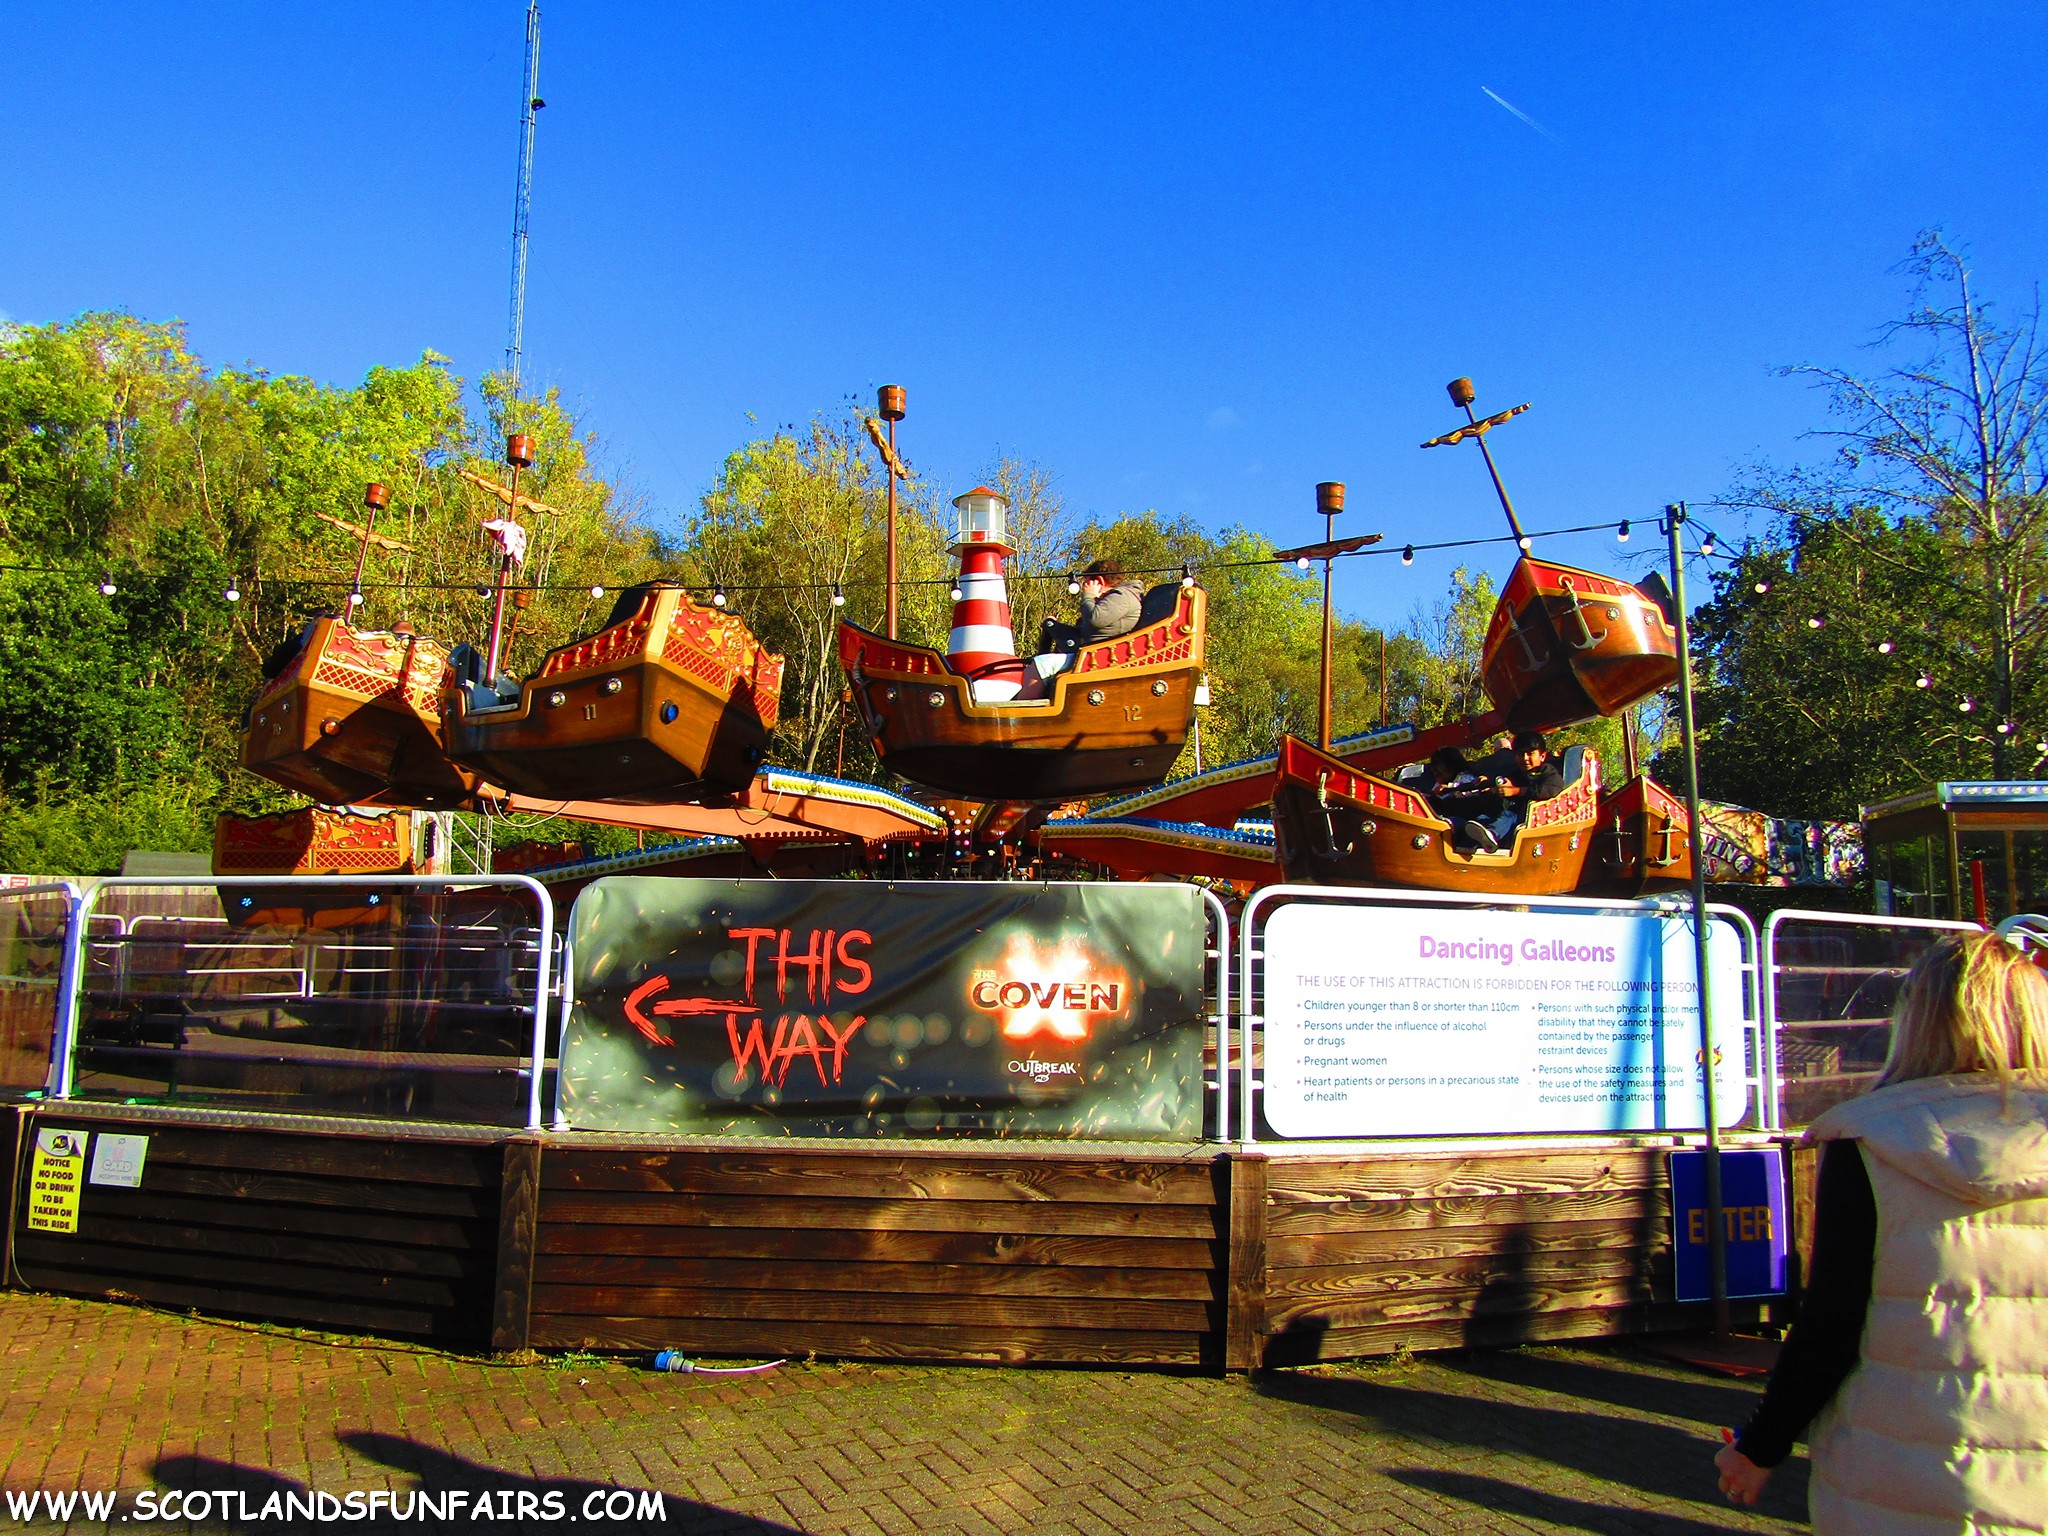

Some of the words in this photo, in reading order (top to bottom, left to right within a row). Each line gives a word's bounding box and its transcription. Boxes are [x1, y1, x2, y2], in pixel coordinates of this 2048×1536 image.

[583, 703, 597, 720] 11
[1123, 704, 1143, 721] 12
[1420, 935, 1513, 966] Dancing
[1520, 938, 1616, 963] Galleons
[728, 927, 873, 1006] THIS
[1296, 975, 1320, 987] THE
[1324, 976, 1346, 987] USE
[1349, 976, 1366, 988] OF
[1369, 976, 1395, 988] THIS
[1398, 977, 1470, 989] ATTRACTION
[1473, 978, 1483, 989] IS
[1486, 979, 1548, 991] FORBIDDEN
[1551, 980, 1572, 991] FOR
[1575, 980, 1595, 992] THE
[1597, 981, 1659, 992] FOLLOWING
[1661, 981, 1699, 993] PERSON
[972, 981, 1119, 1011] COVEN
[1304, 1000, 1345, 1010] Children
[1347, 1003, 1387, 1013] younger
[1390, 1001, 1410, 1011] than
[1412, 1001, 1419, 1011] 8
[1421, 1003, 1431, 1011] or
[1433, 1002, 1466, 1011] shorter
[1468, 1002, 1488, 1012] than
[1491, 1002, 1520, 1012] 110cm
[1538, 1003, 1572, 1013] Persons
[1574, 1003, 1592, 1013] with
[1595, 1003, 1615, 1013] such
[1616, 1003, 1650, 1015] physical
[1652, 1004, 1679, 1014] and/or
[1681, 1005, 1699, 1014] men
[1304, 1020, 1343, 1031] Persons
[1345, 1021, 1374, 1031] under
[1376, 1021, 1392, 1031] the
[1395, 1021, 1438, 1031] influence
[1440, 1021, 1451, 1031] of
[1452, 1021, 1487, 1031] alcohol
[1538, 1018, 1576, 1028] disability
[1578, 1018, 1595, 1027] that
[1597, 1018, 1616, 1029] they
[1618, 1019, 1647, 1027] cannot
[1649, 1018, 1660, 1027] be
[1662, 1018, 1685, 1029] safely
[1304, 1037, 1314, 1045] or
[1317, 1036, 1346, 1047] drugs
[1538, 1032, 1582, 1041] contained
[1583, 1032, 1594, 1043] by
[1596, 1032, 1610, 1041] the
[1612, 1033, 1655, 1043] passenger
[725, 1013, 867, 1091] WAY
[1538, 1046, 1574, 1055] restraint
[1576, 1046, 1607, 1055] devices
[1304, 1056, 1348, 1068] Pregnant
[1351, 1057, 1387, 1066] women
[1008, 1060, 1077, 1077] OUTBREAK
[1538, 1064, 1572, 1074] Persons
[1575, 1065, 1603, 1074] whose
[1605, 1065, 1621, 1073] size
[1623, 1065, 1644, 1073] does
[1645, 1065, 1659, 1073] not
[1661, 1064, 1683, 1073] allow
[1304, 1076, 1331, 1087] Heart
[1334, 1076, 1373, 1088] patients
[1375, 1077, 1386, 1086] or
[1388, 1077, 1426, 1088] persons
[1428, 1075, 1437, 1085] in
[1439, 1077, 1445, 1085] a
[1447, 1075, 1496, 1088] precarious
[1498, 1075, 1519, 1085] state
[1539, 1079, 1553, 1088] the
[1572, 1079, 1582, 1088] of
[1584, 1079, 1598, 1088] the
[1600, 1079, 1625, 1089] safety
[1627, 1080, 1666, 1088] measures
[1668, 1079, 1684, 1087] and
[1304, 1092, 1314, 1101] of
[1317, 1091, 1347, 1101] health
[1539, 1094, 1571, 1103] devices
[1573, 1094, 1594, 1102] used
[1609, 1093, 1624, 1101] the
[1626, 1093, 1666, 1101] attracton
[43, 1157, 70, 1167] NOTICE
[39, 1169, 50, 1178] NO
[52, 1171, 74, 1180] FOOD
[35, 1181, 47, 1190] OR
[50, 1183, 75, 1193] DRINK
[42, 1195, 52, 1203] TO
[53, 1196, 64, 1204] BE
[33, 1206, 59, 1216] TAKEN
[60, 1209, 72, 1217] ON
[32, 1218, 49, 1227] THIS
[51, 1220, 70, 1229] RIDE
